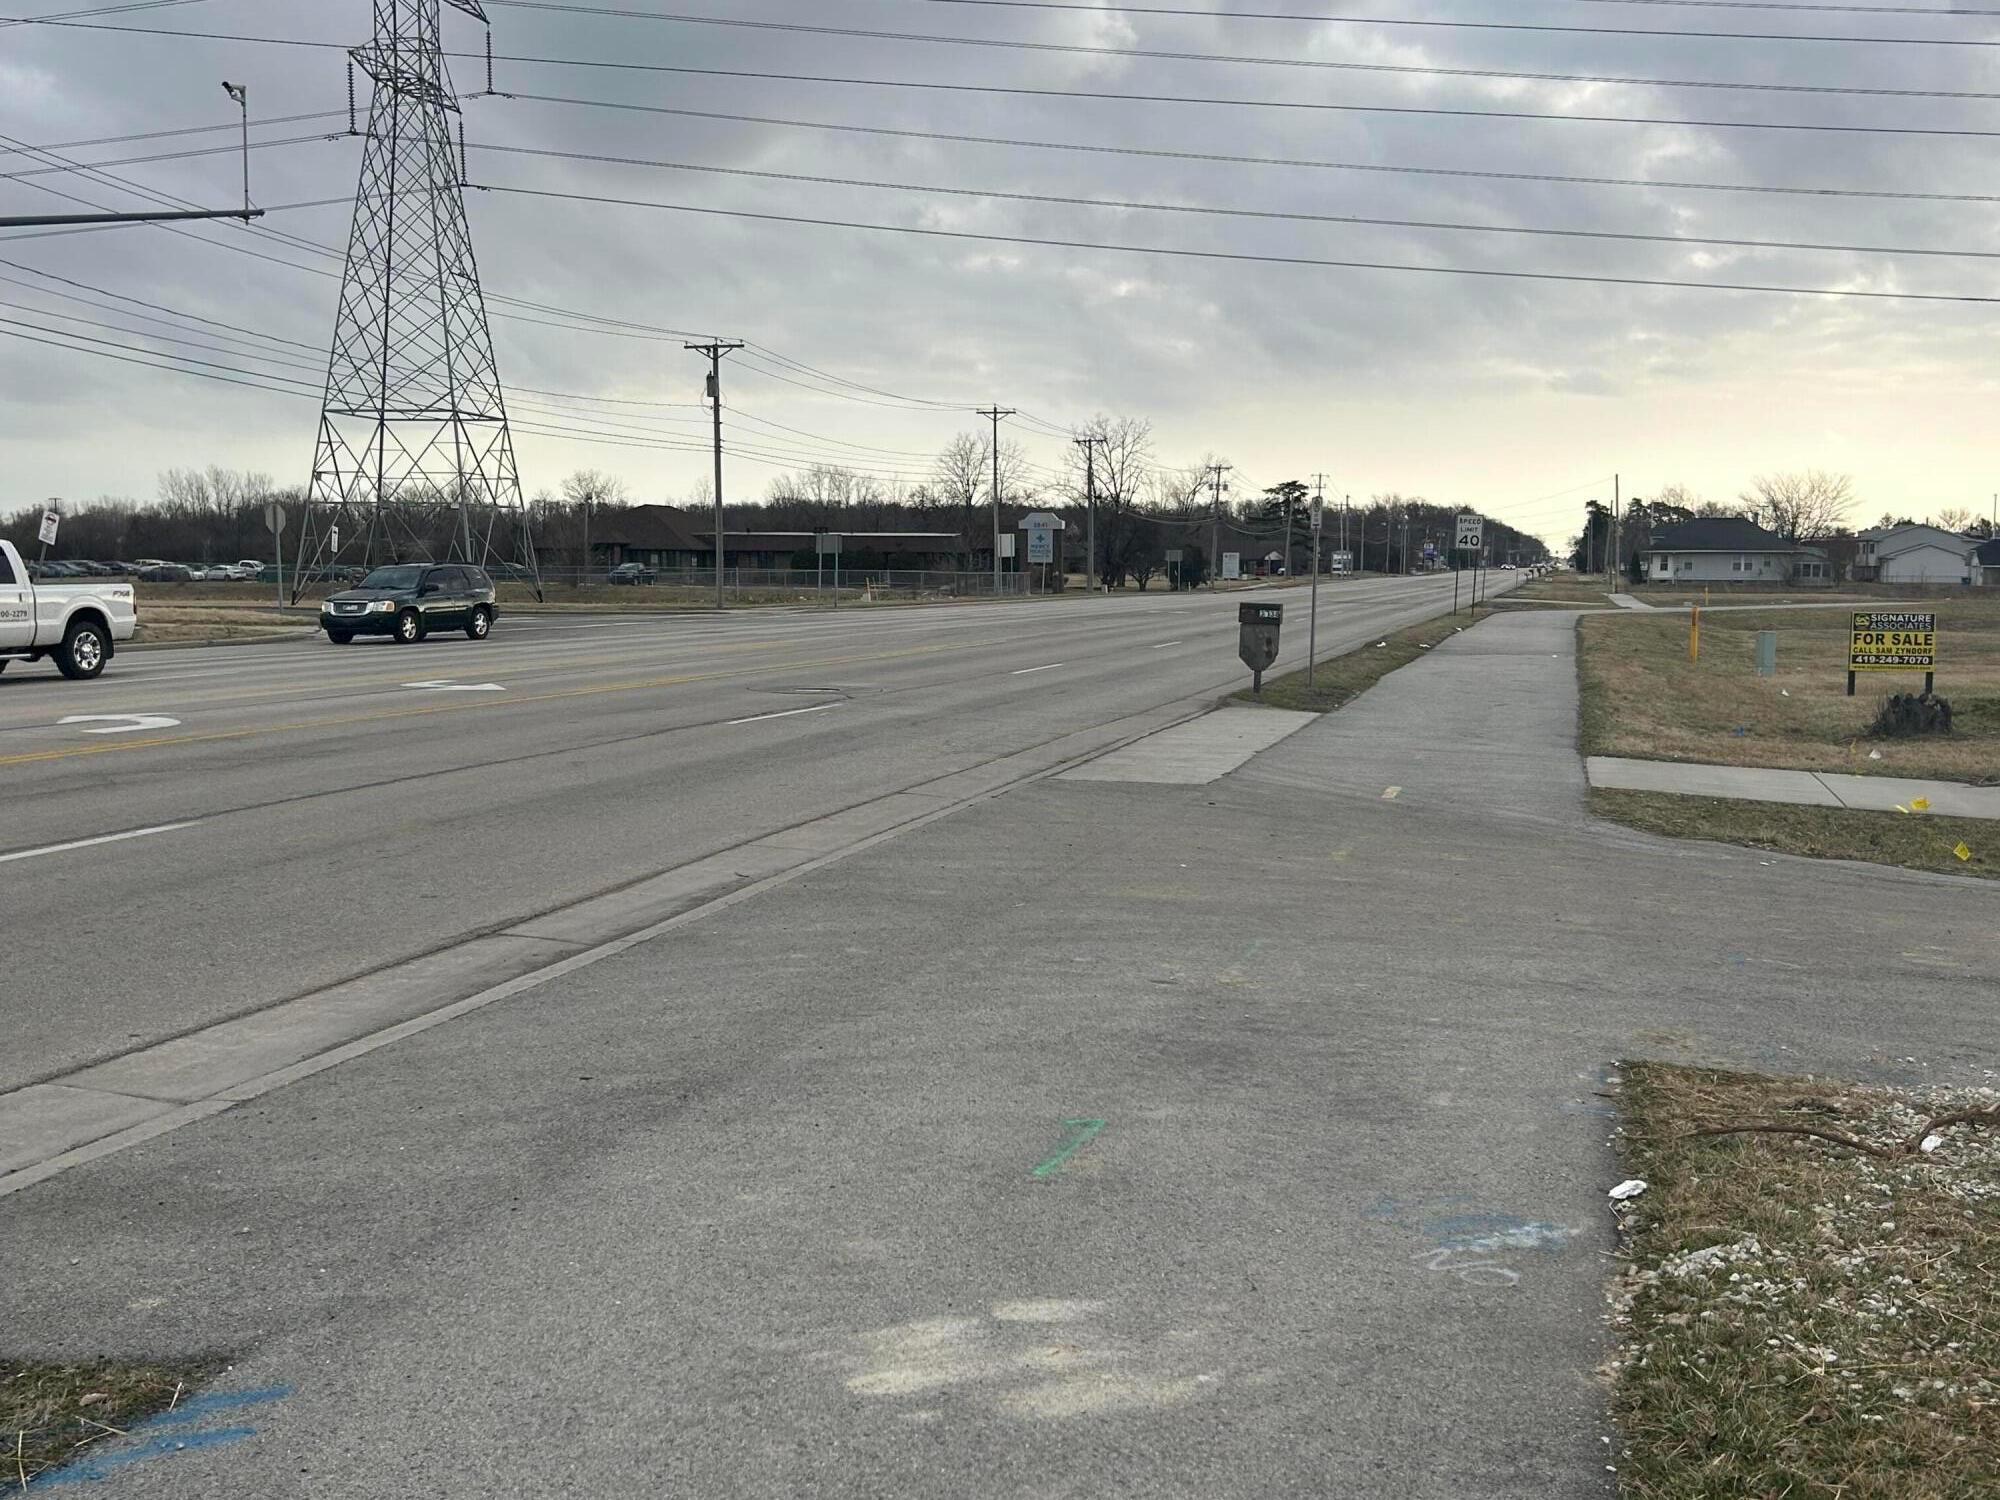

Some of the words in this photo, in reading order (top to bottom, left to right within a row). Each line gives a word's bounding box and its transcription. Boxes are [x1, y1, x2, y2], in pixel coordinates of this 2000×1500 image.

[1460, 517, 1481, 525] SPEED
[1459, 535, 1479, 546] 40
[1871, 614, 1932, 622] SIGNATURE
[1870, 622, 1932, 630] ASSOCIATES
[1853, 633, 1885, 645] FOR
[1891, 633, 1933, 646] SALE
[1853, 646, 1873, 654] CALL
[1855, 656, 1929, 664] 419-249-7070
